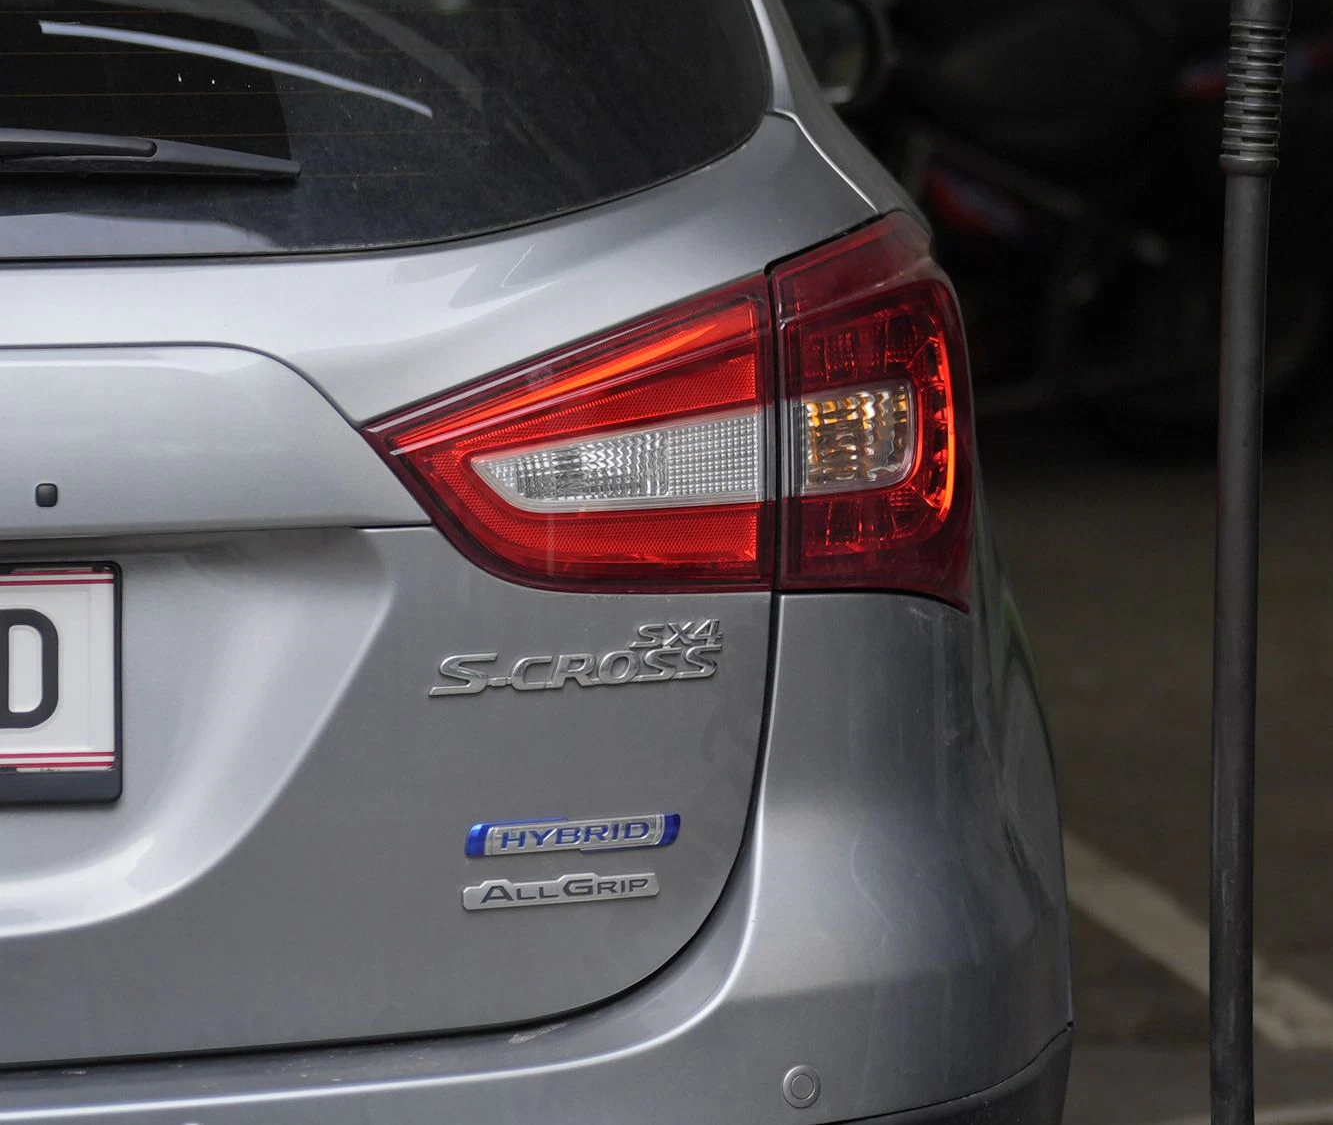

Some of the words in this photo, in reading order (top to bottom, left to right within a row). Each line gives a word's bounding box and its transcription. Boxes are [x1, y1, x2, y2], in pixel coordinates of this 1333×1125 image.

[629, 618, 723, 648] SX4
[0, 608, 59, 729] D
[428, 644, 723, 697] S-CROSS
[501, 821, 651, 851] HYBRID
